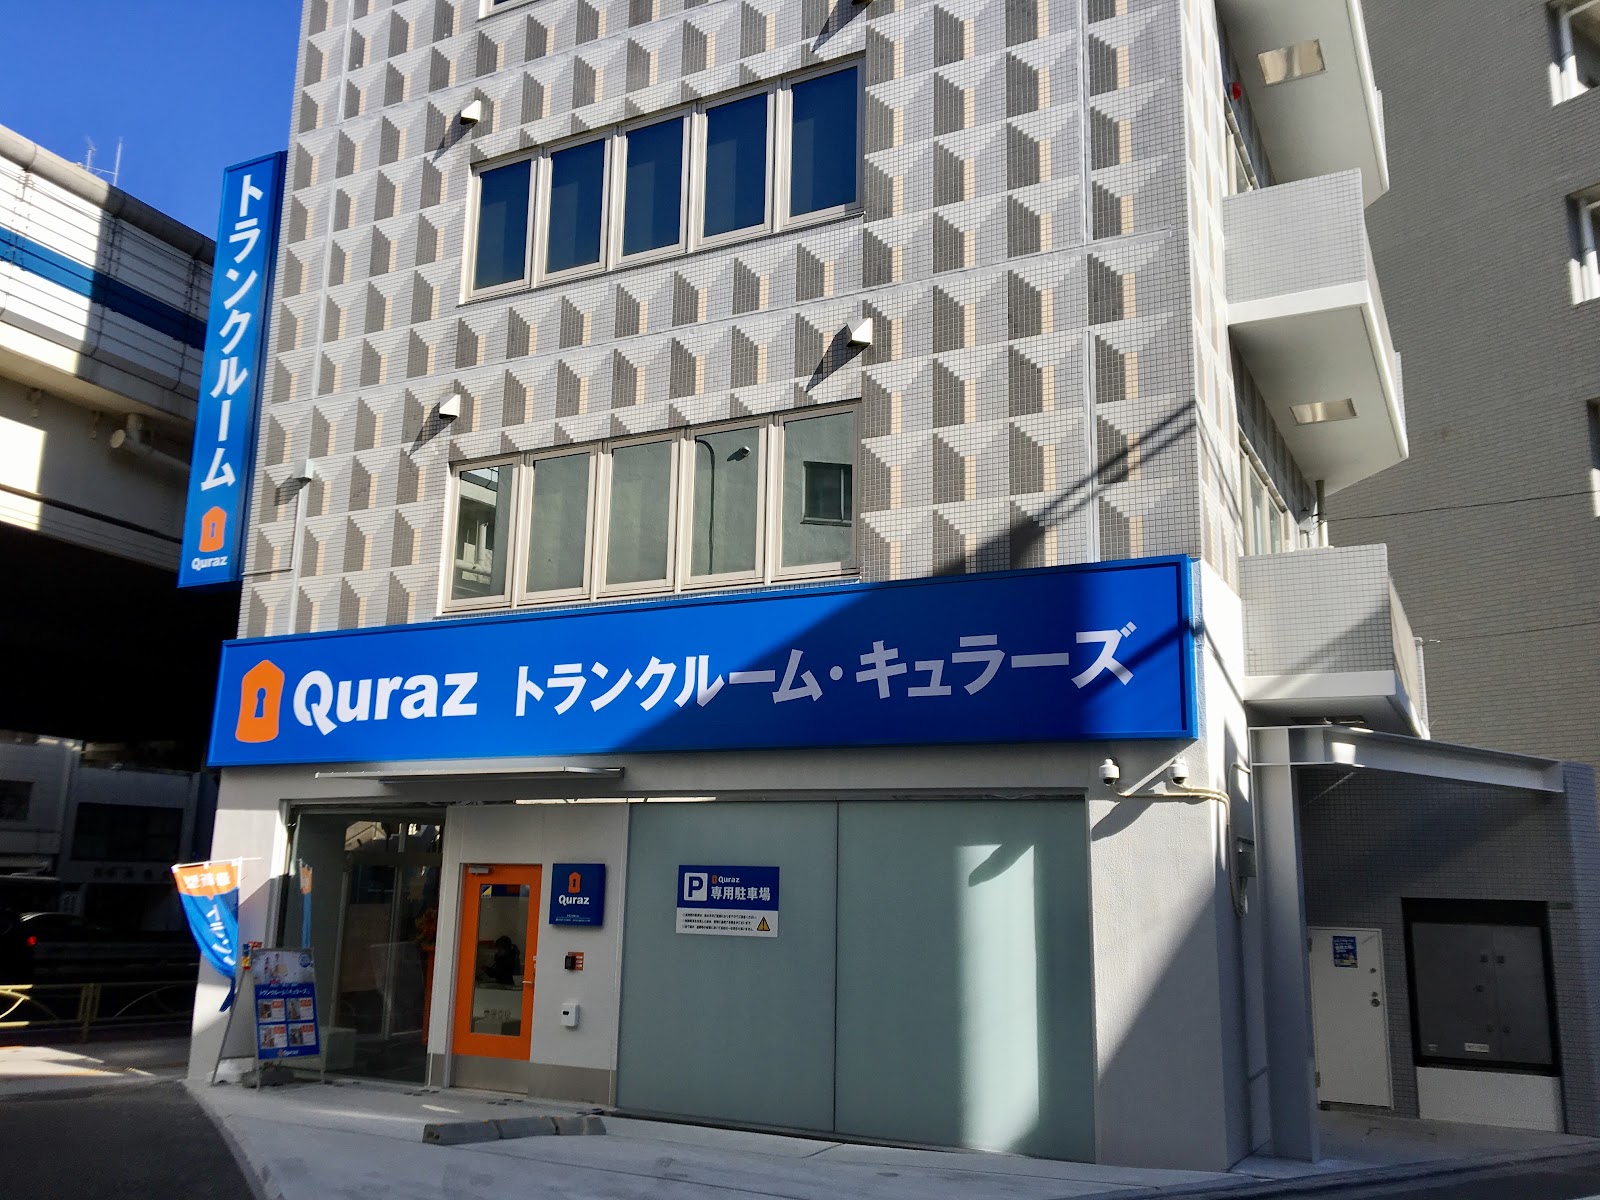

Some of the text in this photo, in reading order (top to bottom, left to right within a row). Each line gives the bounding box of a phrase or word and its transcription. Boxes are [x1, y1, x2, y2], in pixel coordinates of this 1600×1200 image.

[200, 174, 264, 492] トランクルーム
[191, 555, 228, 571] Quraz
[293, 621, 1138, 736] Quraz トランクルーム・キュラーズ
[687, 876, 704, 898] P
[718, 876, 740, 884] Quraz
[558, 895, 590, 906] Quraz
[711, 886, 771, 902] 専用駐車場
